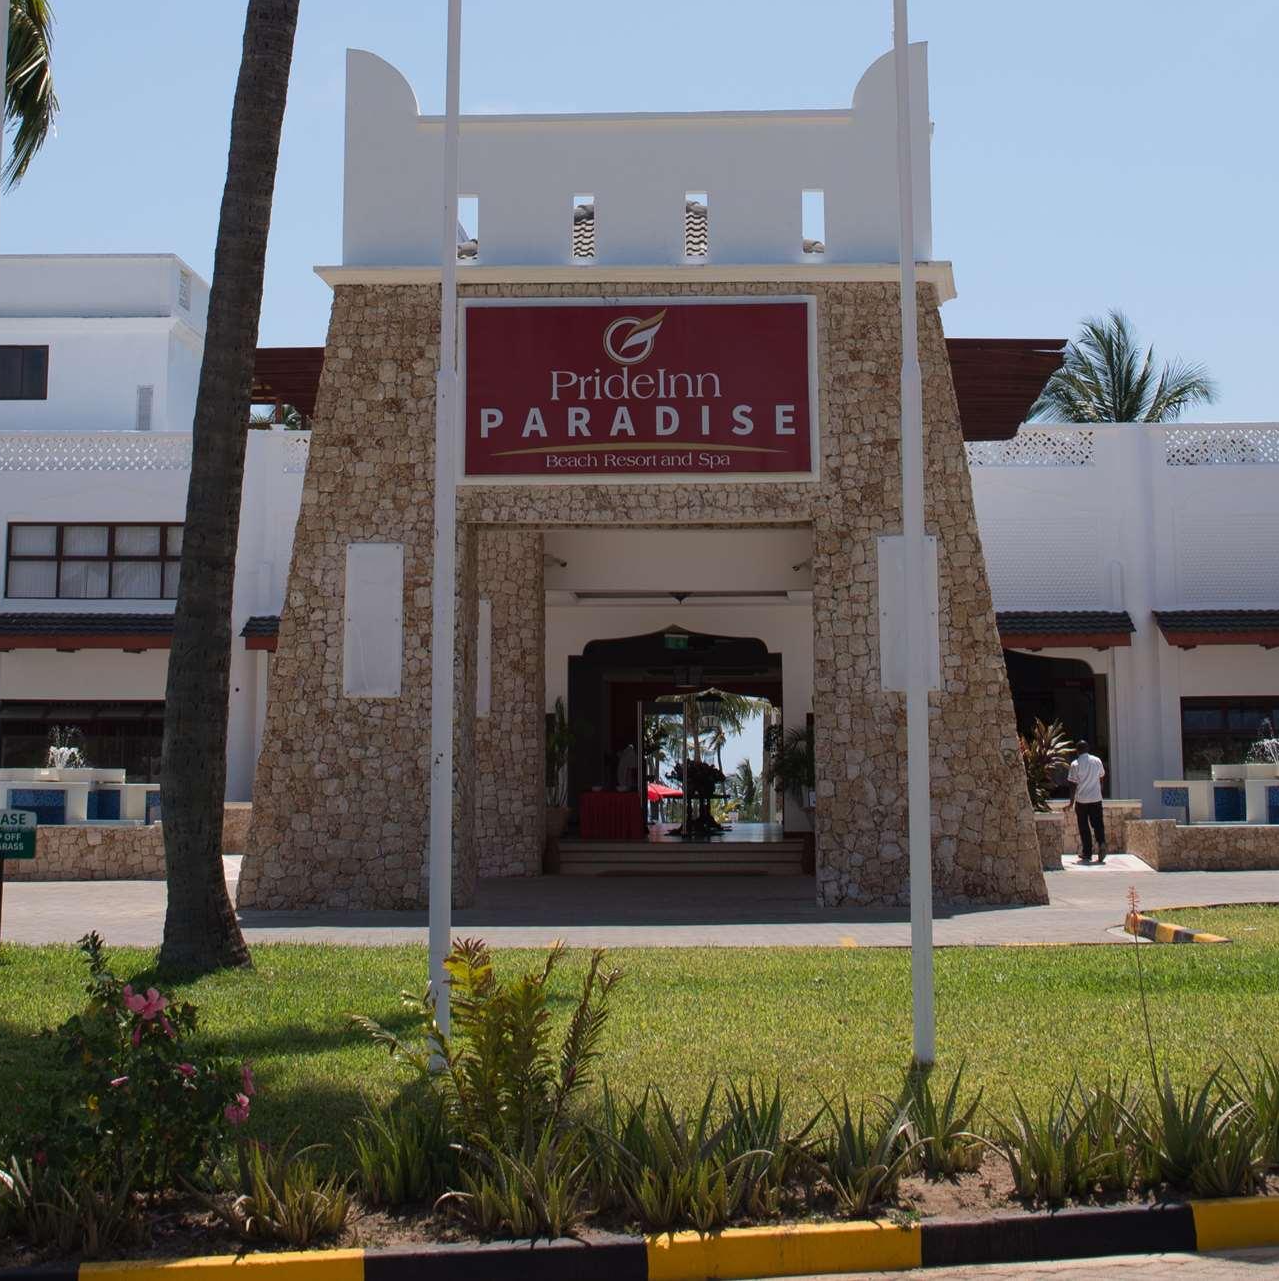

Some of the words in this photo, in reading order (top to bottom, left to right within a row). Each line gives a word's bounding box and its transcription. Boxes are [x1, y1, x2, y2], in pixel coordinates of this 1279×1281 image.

[550, 367, 722, 401] PrideInn
[480, 405, 796, 438] PARADISE
[546, 454, 598, 468] Beach
[604, 453, 656, 467] Resort
[660, 452, 693, 467] and
[698, 452, 731, 469] Spa
[5, 833, 22, 841] OFF
